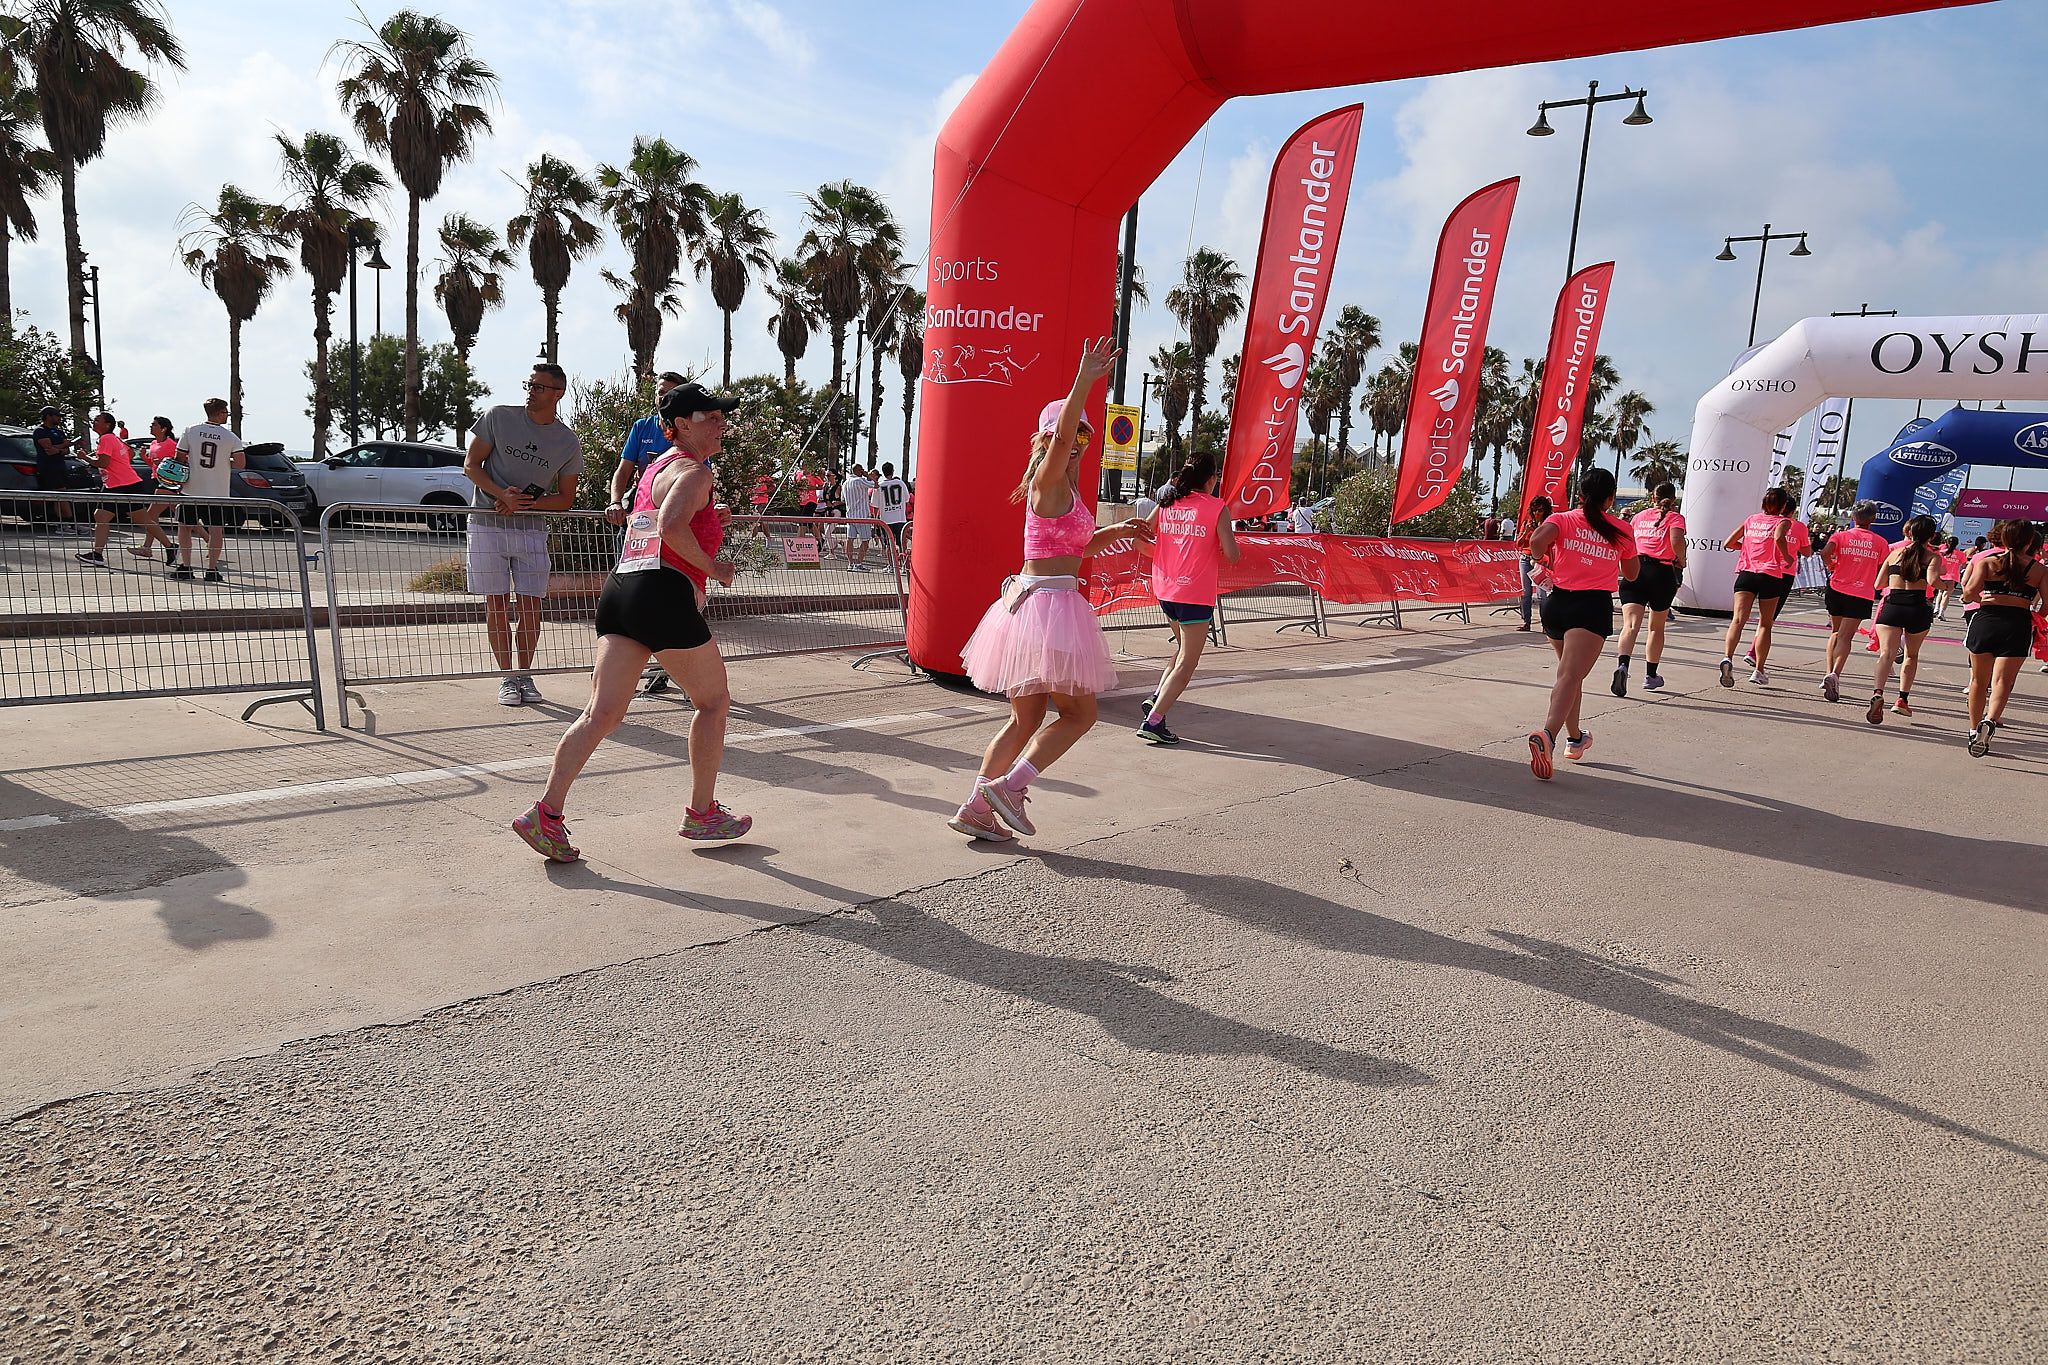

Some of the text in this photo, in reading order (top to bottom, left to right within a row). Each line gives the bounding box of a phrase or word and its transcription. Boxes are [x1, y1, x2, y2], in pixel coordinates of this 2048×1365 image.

[1278, 141, 1337, 337] Santander
[933, 256, 999, 288] Sports
[1442, 227, 1491, 374] Santander
[927, 303, 1044, 332] Santander
[1557, 283, 1599, 412] Santander
[1731, 379, 1796, 393] OYSHO
[200, 441, 217, 469] 9
[504, 445, 549, 469] SCOTTA
[1240, 396, 1294, 505] Sports
[1417, 417, 1454, 499] Sports
[1893, 449, 1951, 463] ASTURIANA
[1692, 458, 1750, 473] OYSHO
[881, 484, 902, 507] 10
[2002, 503, 2029, 511] OYSHO
[1563, 537, 1618, 561] IMPARABLES
[1840, 547, 1879, 560] IMPARABLES
[1848, 538, 1873, 549] SOMOS
